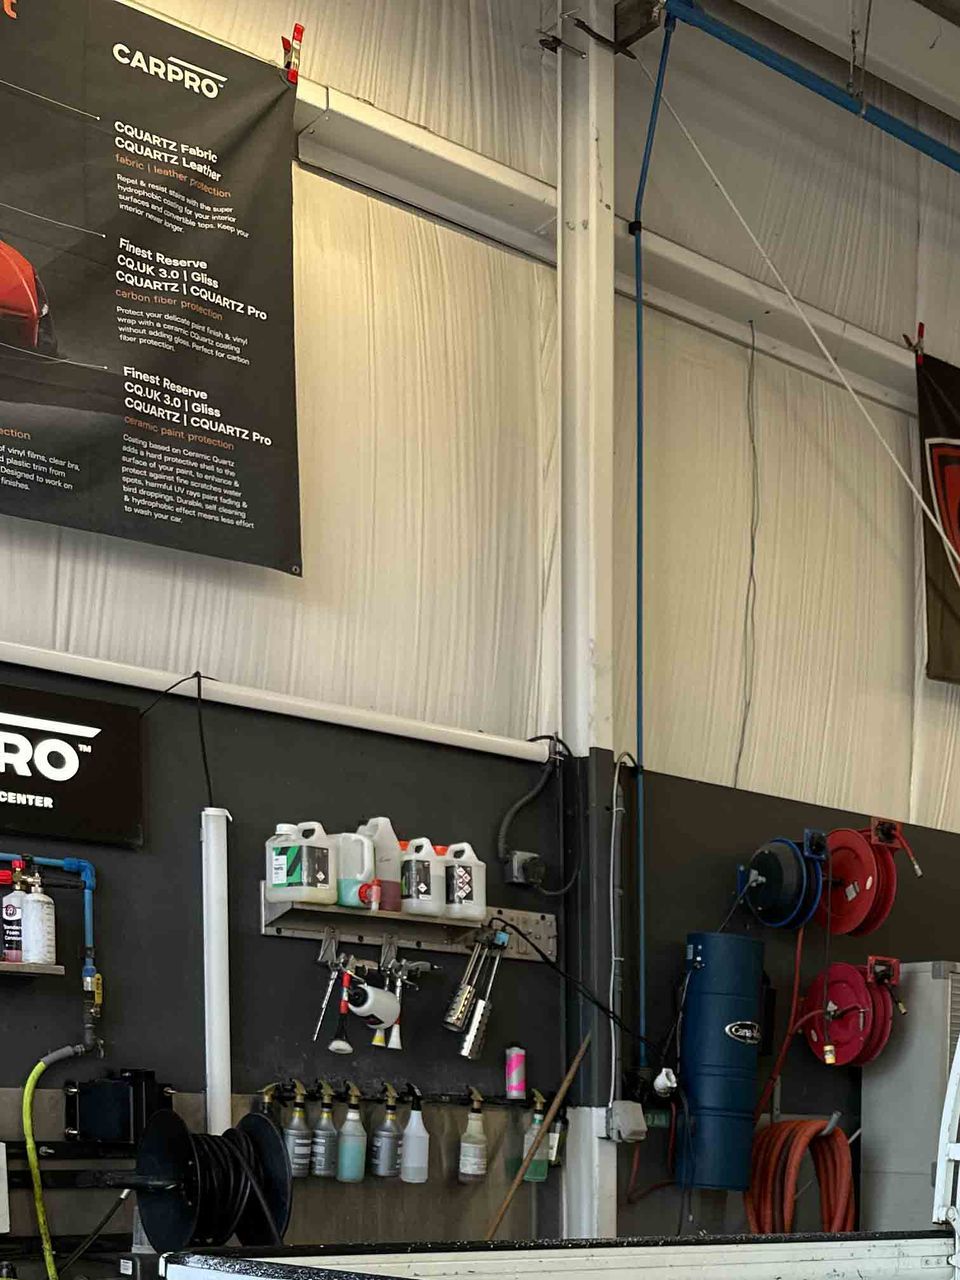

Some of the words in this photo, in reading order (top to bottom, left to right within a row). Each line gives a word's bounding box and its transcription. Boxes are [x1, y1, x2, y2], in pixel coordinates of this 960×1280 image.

[112, 43, 219, 99] CARPRO
[114, 122, 177, 151] CQUARTZ
[180, 144, 218, 162] Fabric
[115, 137, 178, 165] CQUARTZ
[182, 157, 221, 181] Leather
[120, 238, 152, 259] Finest
[156, 252, 207, 269] Reserve
[118, 255, 155, 276] CQ.UK
[159, 268, 179, 280] 3.0
[191, 272, 219, 288] Gliss
[116, 271, 179, 292] CQUARTZ
[190, 286, 244, 313] CQUARTZ
[248, 305, 267, 319] Pro
[116, 290, 150, 301] carbon
[154, 295, 177, 305] fiber
[181, 301, 223, 320] protection
[124, 366, 160, 385] Finest
[163, 379, 208, 398] Reserve
[124, 382, 161, 401] CQ.UK
[164, 394, 180, 408] 3.0
[192, 403, 220, 417] Gliss
[125, 398, 180, 423] CQUARTZ
[191, 417, 249, 439] CQUARTZ
[253, 432, 272, 445] Pro
[125, 417, 158, 431] ceramic
[160, 428, 185, 438] paint
[188, 434, 234, 450] protection
[0, 790, 54, 809] CENTER
